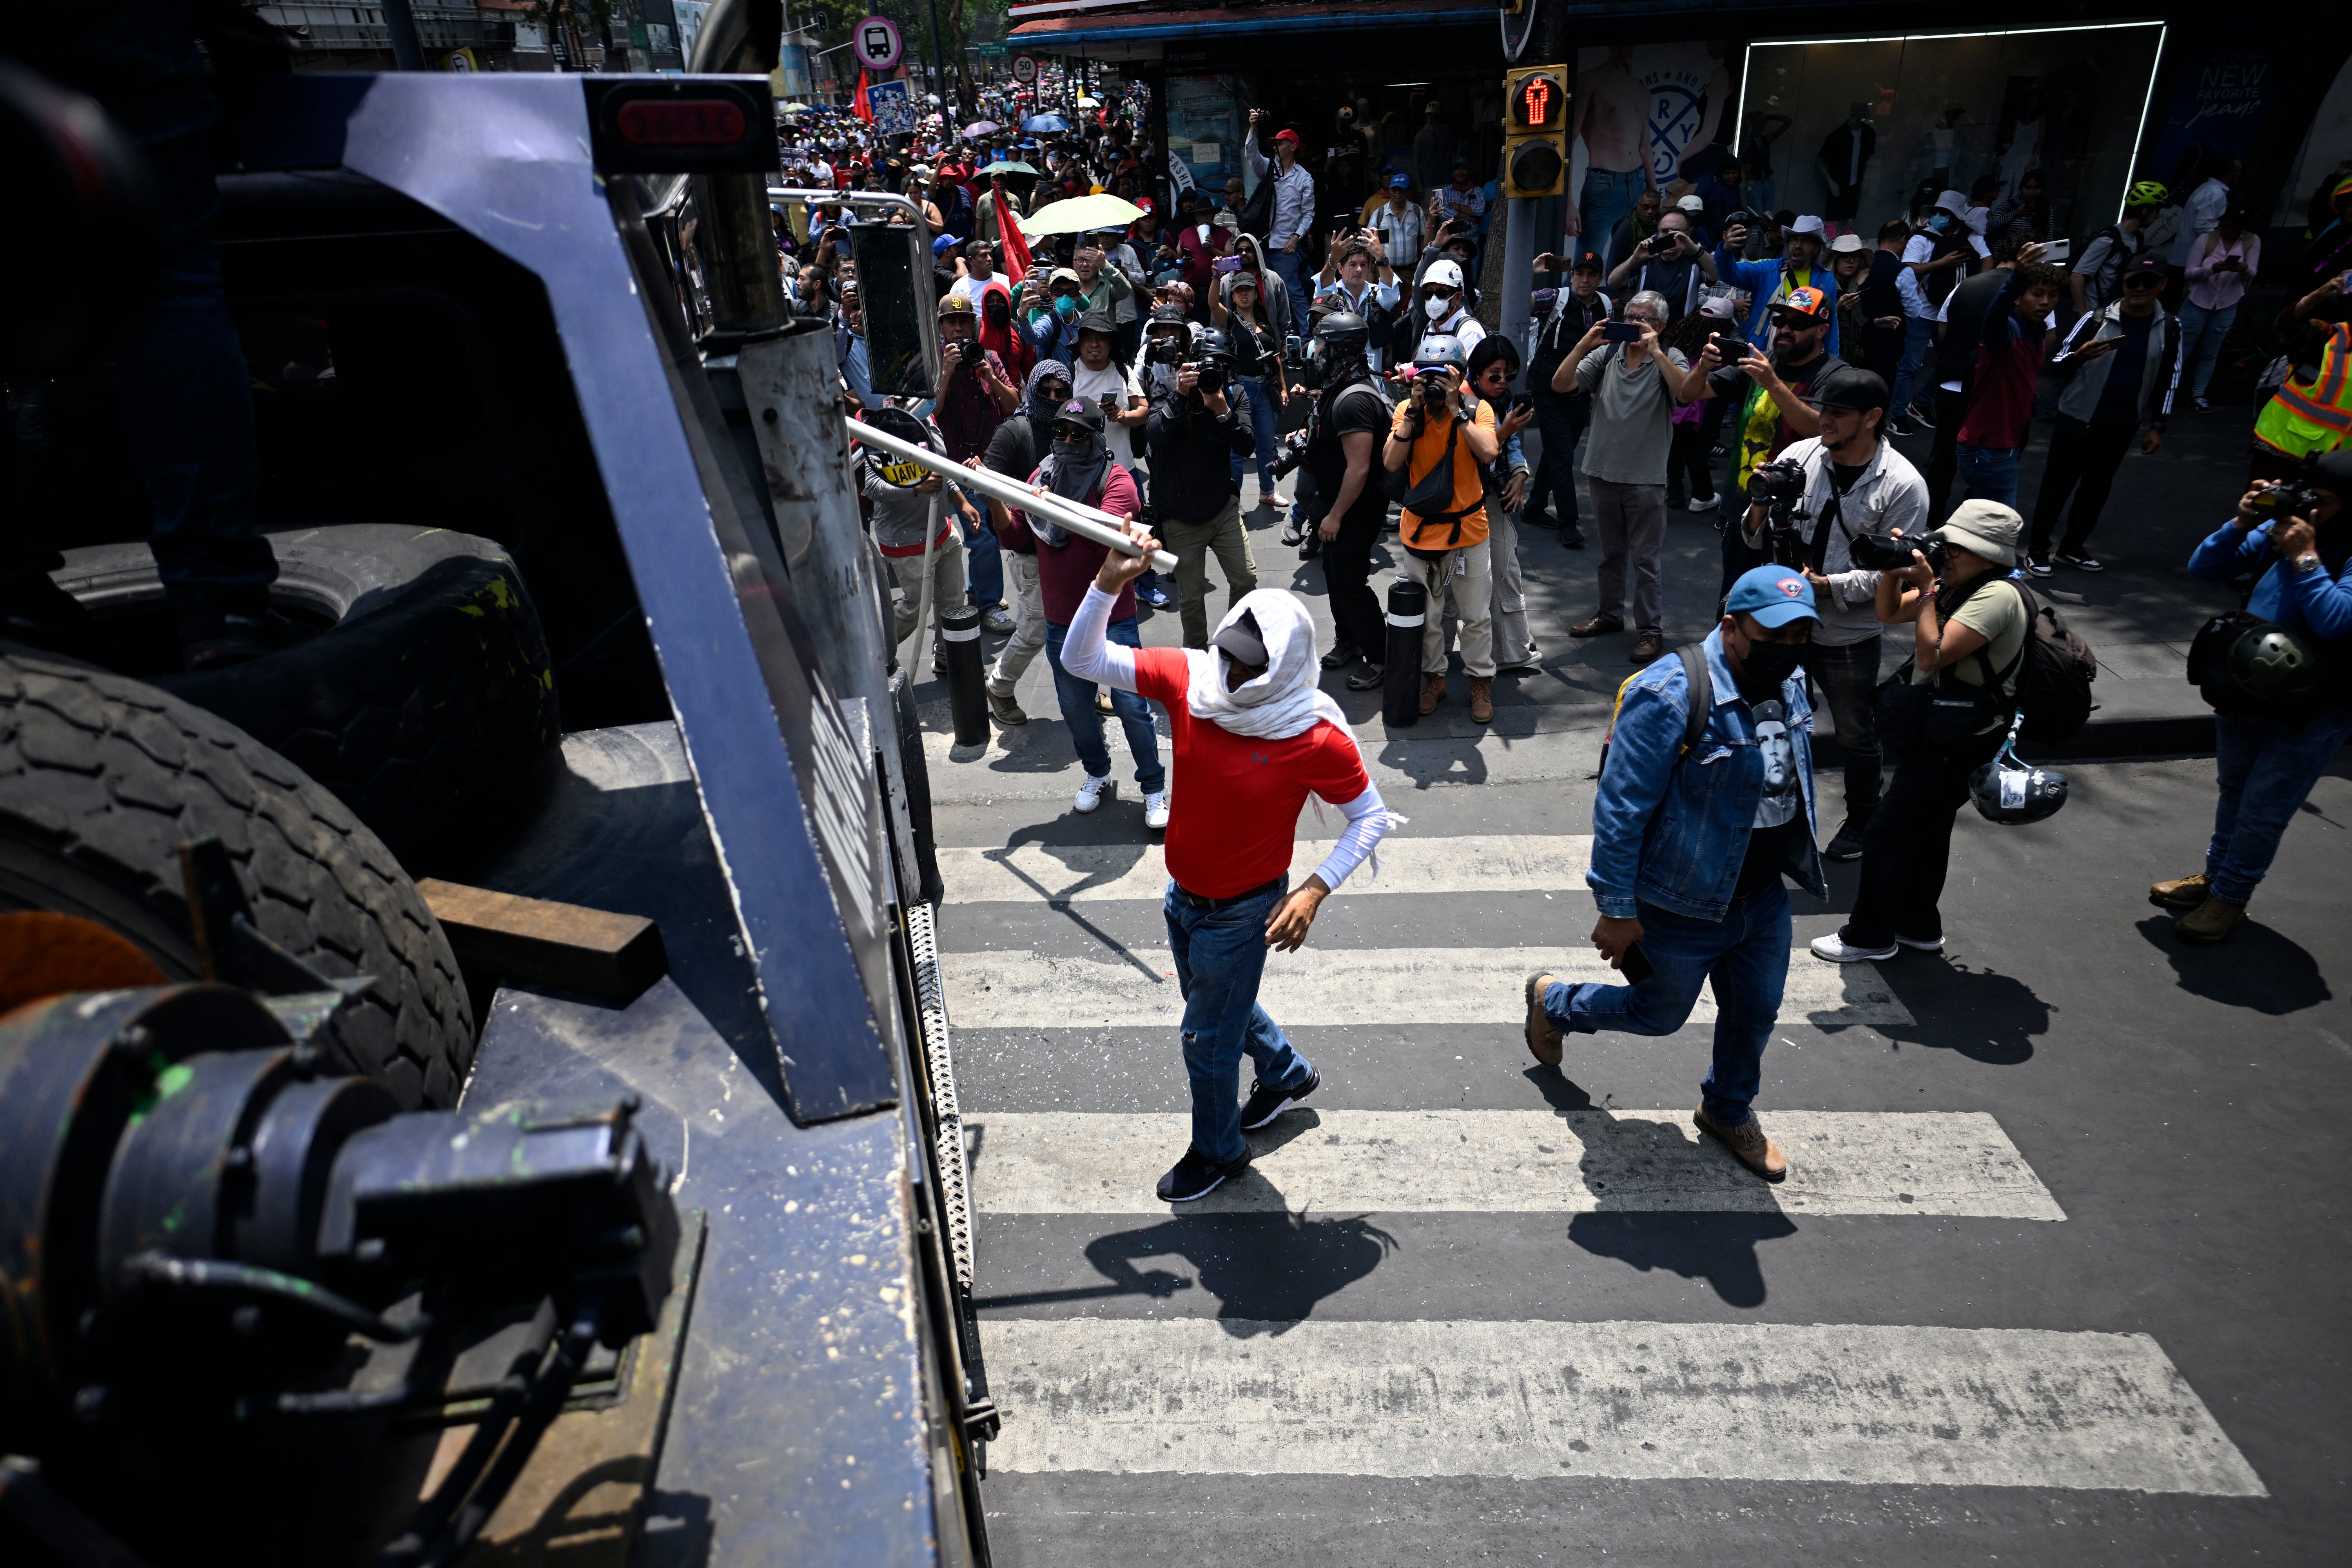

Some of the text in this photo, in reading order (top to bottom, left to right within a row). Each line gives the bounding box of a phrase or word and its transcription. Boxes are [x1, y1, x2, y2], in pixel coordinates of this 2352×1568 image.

[1019, 61, 1031, 70] 50
[1675, 71, 1698, 87] AND
[2200, 63, 2267, 88] NEW
[2196, 87, 2261, 100] FAVORITE
[1658, 99, 1670, 119] R
[2184, 100, 2261, 129] jeans
[1168, 156, 1191, 187] FASHI
[952, 297, 962, 309] SD
[1243, 320, 1256, 336] GUESS
